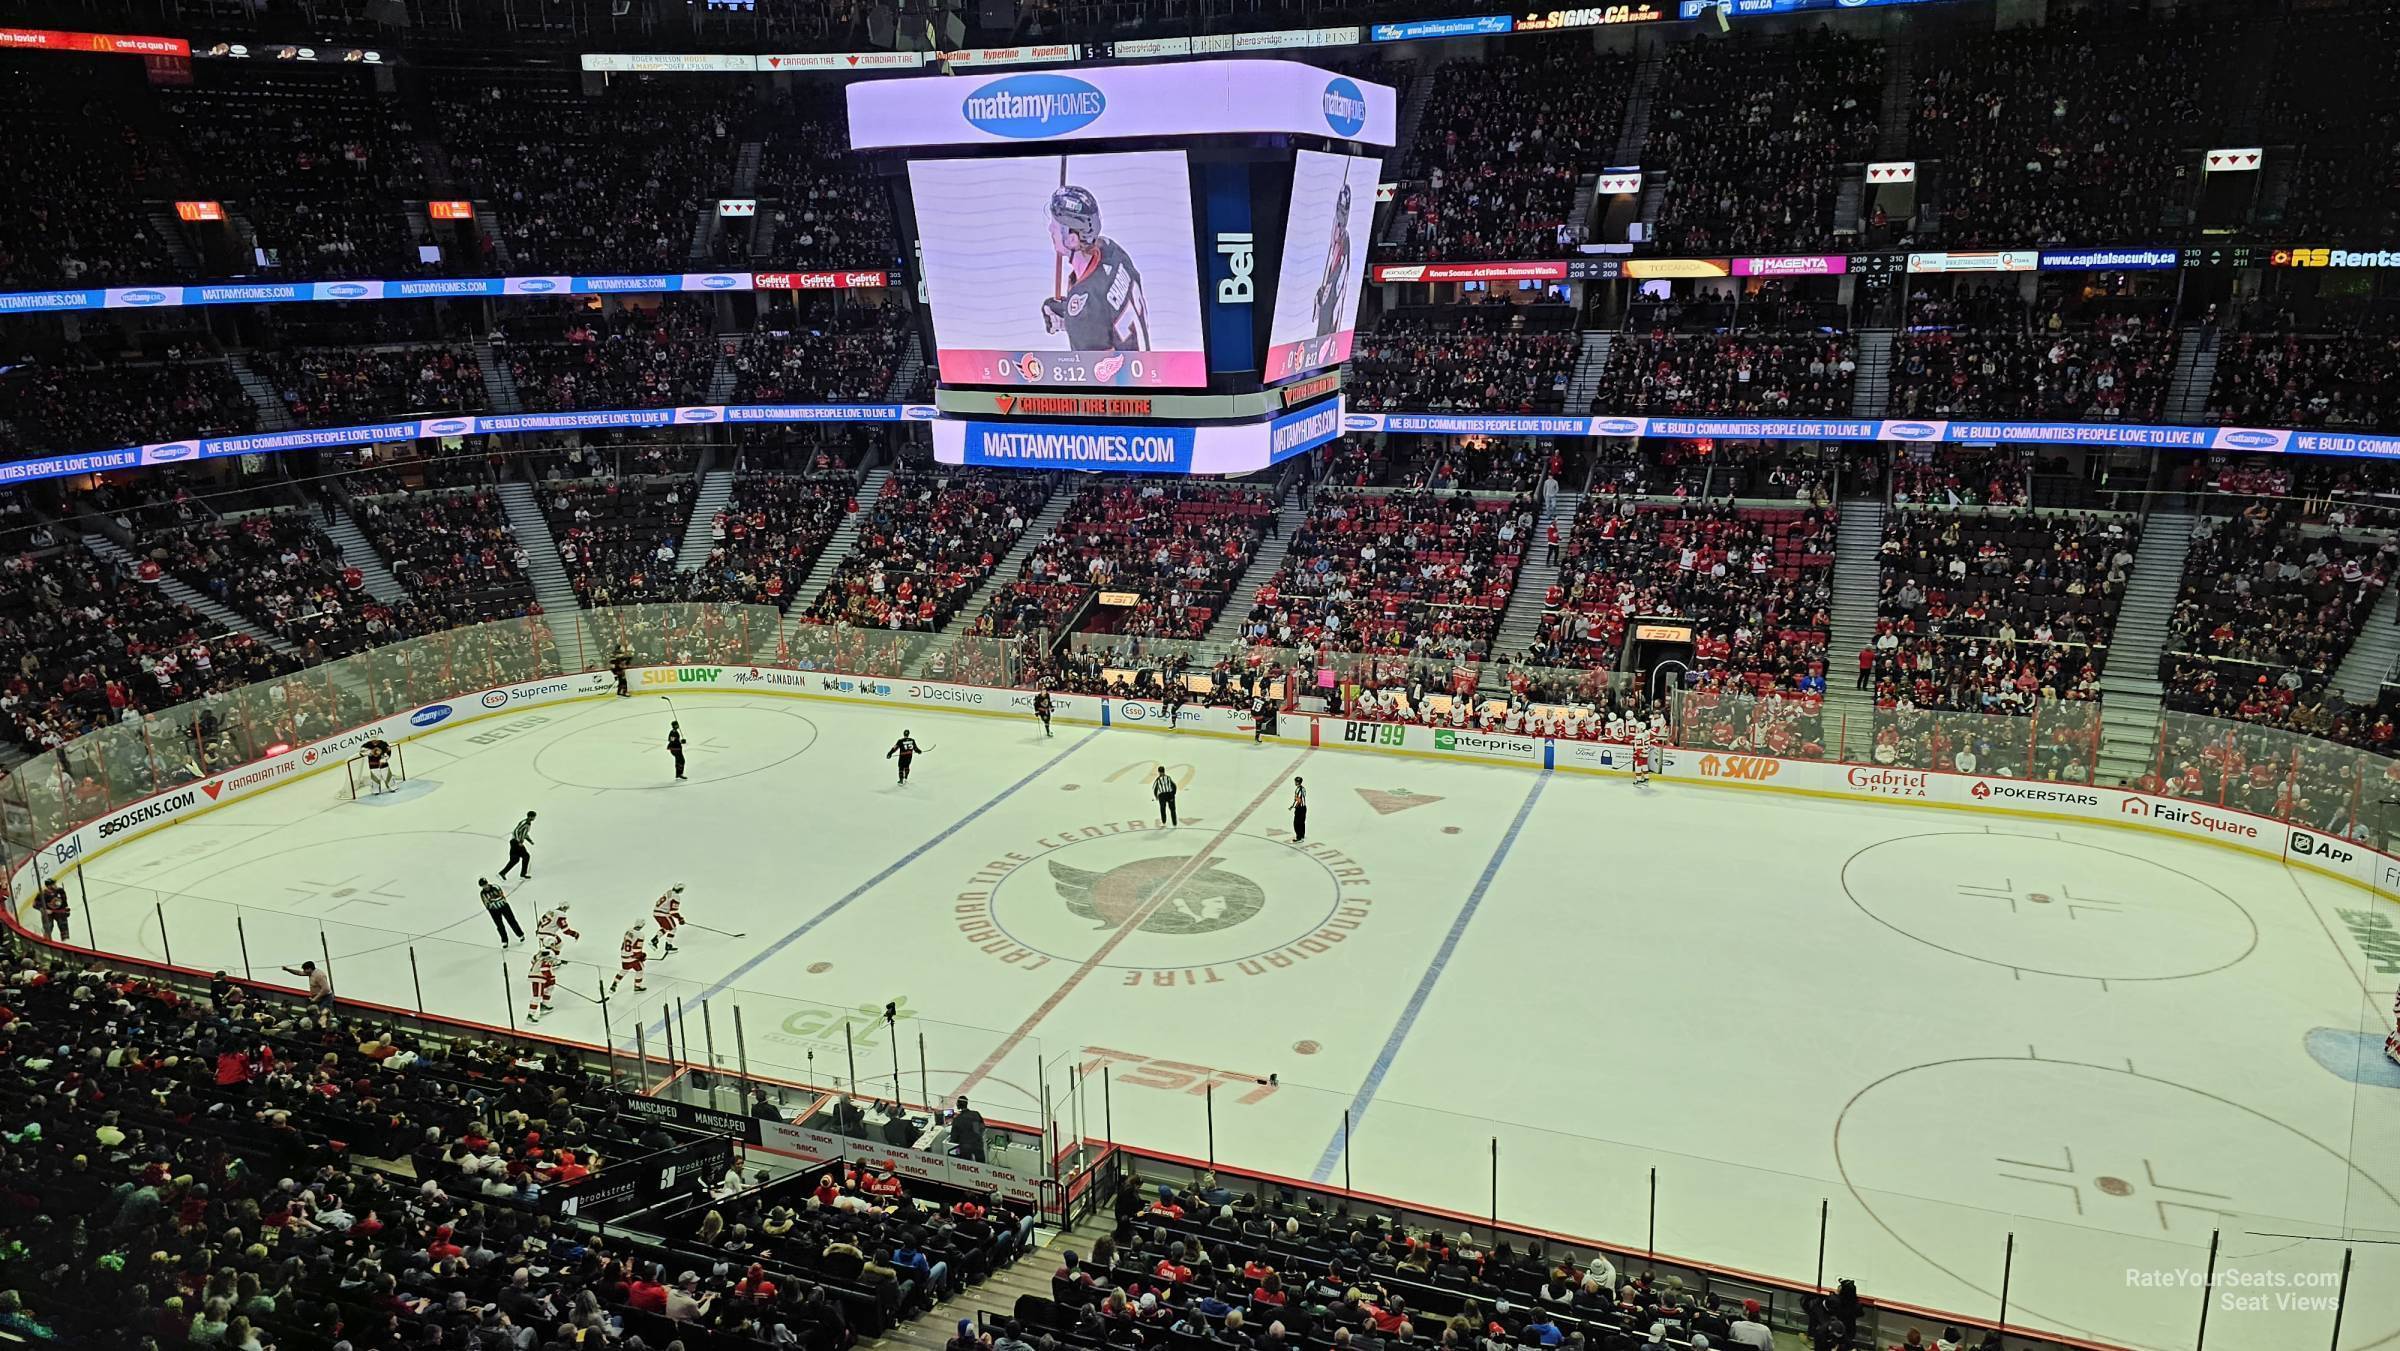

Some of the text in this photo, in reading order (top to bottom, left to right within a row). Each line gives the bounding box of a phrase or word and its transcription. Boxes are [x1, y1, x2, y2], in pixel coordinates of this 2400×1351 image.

[1546, 5, 1629, 28] SIGNS.CA
[983, 48, 1019, 60] Hyperline
[1032, 46, 1069, 58] Hyperline
[820, 57, 835, 65] TIRE
[861, 56, 913, 65] CANADIAN TIRE
[968, 92, 1100, 122] mattamyHOMES
[1889, 255, 1904, 263] 310
[2043, 252, 2176, 268] www.capitalsecurity.ca
[2184, 249, 2201, 257] 310
[1218, 232, 1254, 303] Bell
[1765, 258, 1828, 268] MAGENTA
[2184, 258, 2200, 266] 210
[755, 274, 790, 285] Gabriel
[800, 274, 835, 285] Gabriel
[845, 272, 880, 285] Gabriel
[1429, 270, 1447, 279] Know
[1474, 268, 1485, 277] Act
[1486, 268, 1507, 277] Faster.
[1535, 267, 1558, 275] Waste.
[401, 282, 487, 294] MATTAMYHOMES.COM
[587, 278, 667, 290] MATTAMYHOMES.COM
[202, 287, 295, 300] MATTAMYHOMES.COM
[998, 358, 1010, 376] 0
[1053, 366, 1087, 382] 8:12
[1131, 360, 1143, 378] 0
[729, 408, 896, 418] WE BUILD COMMUNITIES PEOPLE LOVE TO LIVE IN
[1019, 397, 1151, 416] CANADIAN TIRE CENTRE
[480, 411, 669, 430] WE BUILD COMMUNITIES PEOPLE LOVE TO LIVE IN
[1389, 418, 1583, 432] WE BUILD COMMUNITIES PEOPLE LOVE TO LIVE IN
[1273, 410, 1336, 454] MATTAMYHOMES.COM
[1652, 423, 1871, 437] WE BUILD COMMUNITIES PEOPLE LOVE TO LIVE IN
[1952, 426, 2205, 444] WE BUILD COMMUNITIES PEOPLE LOVE TO LIVE IN
[206, 425, 414, 455] WE BUILD COMMUNITIES PEOPLE LOVE TO LIVE IN
[983, 431, 1174, 463] MATTAMYHOMES.COM
[2297, 436, 2355, 452] WE BUILD
[27, 452, 135, 476] PEOPLE LOVE TO LIVE IN
[1106, 594, 1134, 605] TSN
[1644, 628, 1681, 640] TSN
[641, 668, 723, 688] SUBWAY
[767, 673, 806, 688] CANADIAN
[512, 681, 568, 700] Supreme
[923, 685, 983, 704] Decisive
[1344, 721, 1406, 746] BET99
[320, 727, 384, 756] AIR CANADA
[1438, 732, 1533, 753] enterprise
[228, 760, 295, 792] CANADIAN TIRE
[1722, 756, 1780, 781] SKIP
[1847, 767, 1928, 789] Gabriel
[1871, 786, 1926, 799] PIZZA
[1994, 786, 2098, 806] POKERSTARS
[98, 791, 195, 841] 5050SENS.COM
[2154, 804, 2258, 838] FairSquare
[56, 834, 82, 865] Bell
[955, 851, 1051, 971] CANADIAN TIRE
[1124, 898, 1372, 987] CANADIAN TIRE
[628, 1098, 677, 1118] MANSCAPED
[695, 1112, 746, 1133] MANSCAPED
[778, 1127, 800, 1139] BRICK
[811, 1135, 833, 1146] BRICK
[796, 1144, 818, 1155] BRICK
[852, 1143, 874, 1154] BRICK
[886, 1150, 909, 1161] BRICK
[921, 1156, 944, 1167] BRICK
[956, 1162, 980, 1174] BRICK
[905, 1165, 928, 1176] BRICK
[992, 1170, 1016, 1182] BRICK
[975, 1179, 998, 1190] BRICK
[579, 1181, 635, 1205] brookstreet
[1011, 1188, 1035, 1199] BRICK
